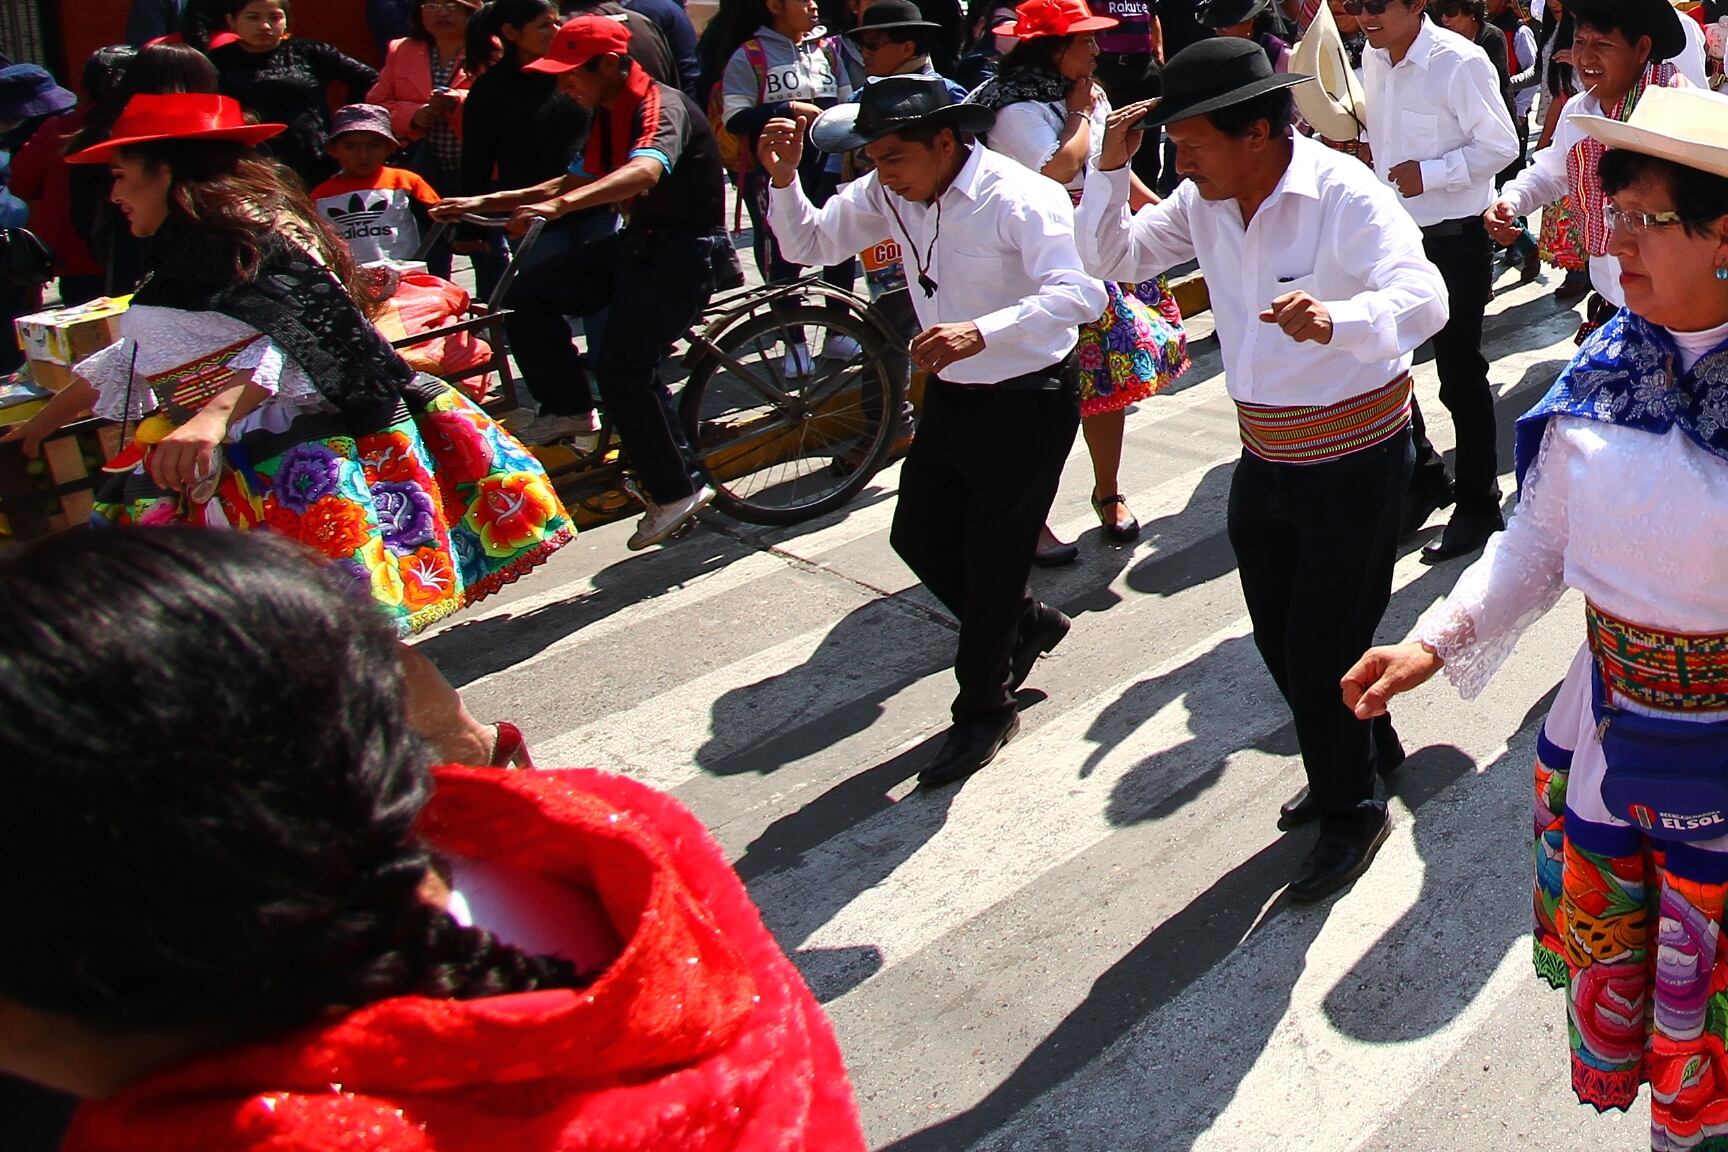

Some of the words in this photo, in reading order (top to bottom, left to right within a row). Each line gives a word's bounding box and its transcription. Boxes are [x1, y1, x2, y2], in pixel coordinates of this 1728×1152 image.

[1108, 0, 1149, 14] Rakute
[766, 67, 834, 94] BOS
[1661, 817, 1686, 830] EL
[1686, 813, 1725, 829] SOL
